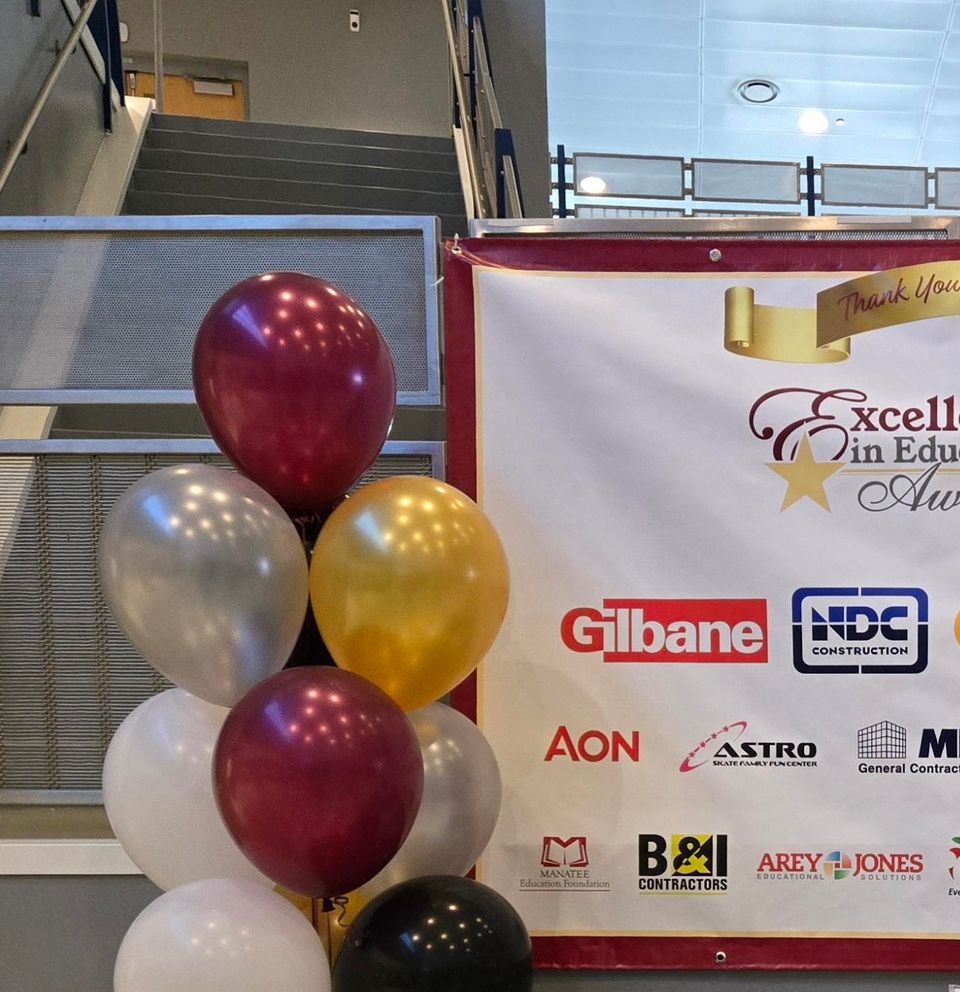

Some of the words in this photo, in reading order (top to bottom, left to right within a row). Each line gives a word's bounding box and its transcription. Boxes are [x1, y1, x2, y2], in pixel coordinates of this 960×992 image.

[837, 277, 910, 320] Thank
[915, 274, 960, 304] You
[851, 437, 885, 463] in
[560, 607, 764, 654] Gilbane
[812, 606, 908, 641] NDC
[812, 647, 908, 655] CONSTRUCTION
[544, 725, 640, 763] AON
[713, 742, 817, 758] ASTRO
[858, 763, 906, 774] General
[638, 834, 728, 877] B&I
[757, 853, 823, 872] AREY
[853, 853, 923, 877] JONES
[519, 879, 561, 888] Education
[564, 879, 610, 888] Foundation
[540, 870, 590, 878] MANATEE
[638, 878, 728, 890] CONTRACTORS
